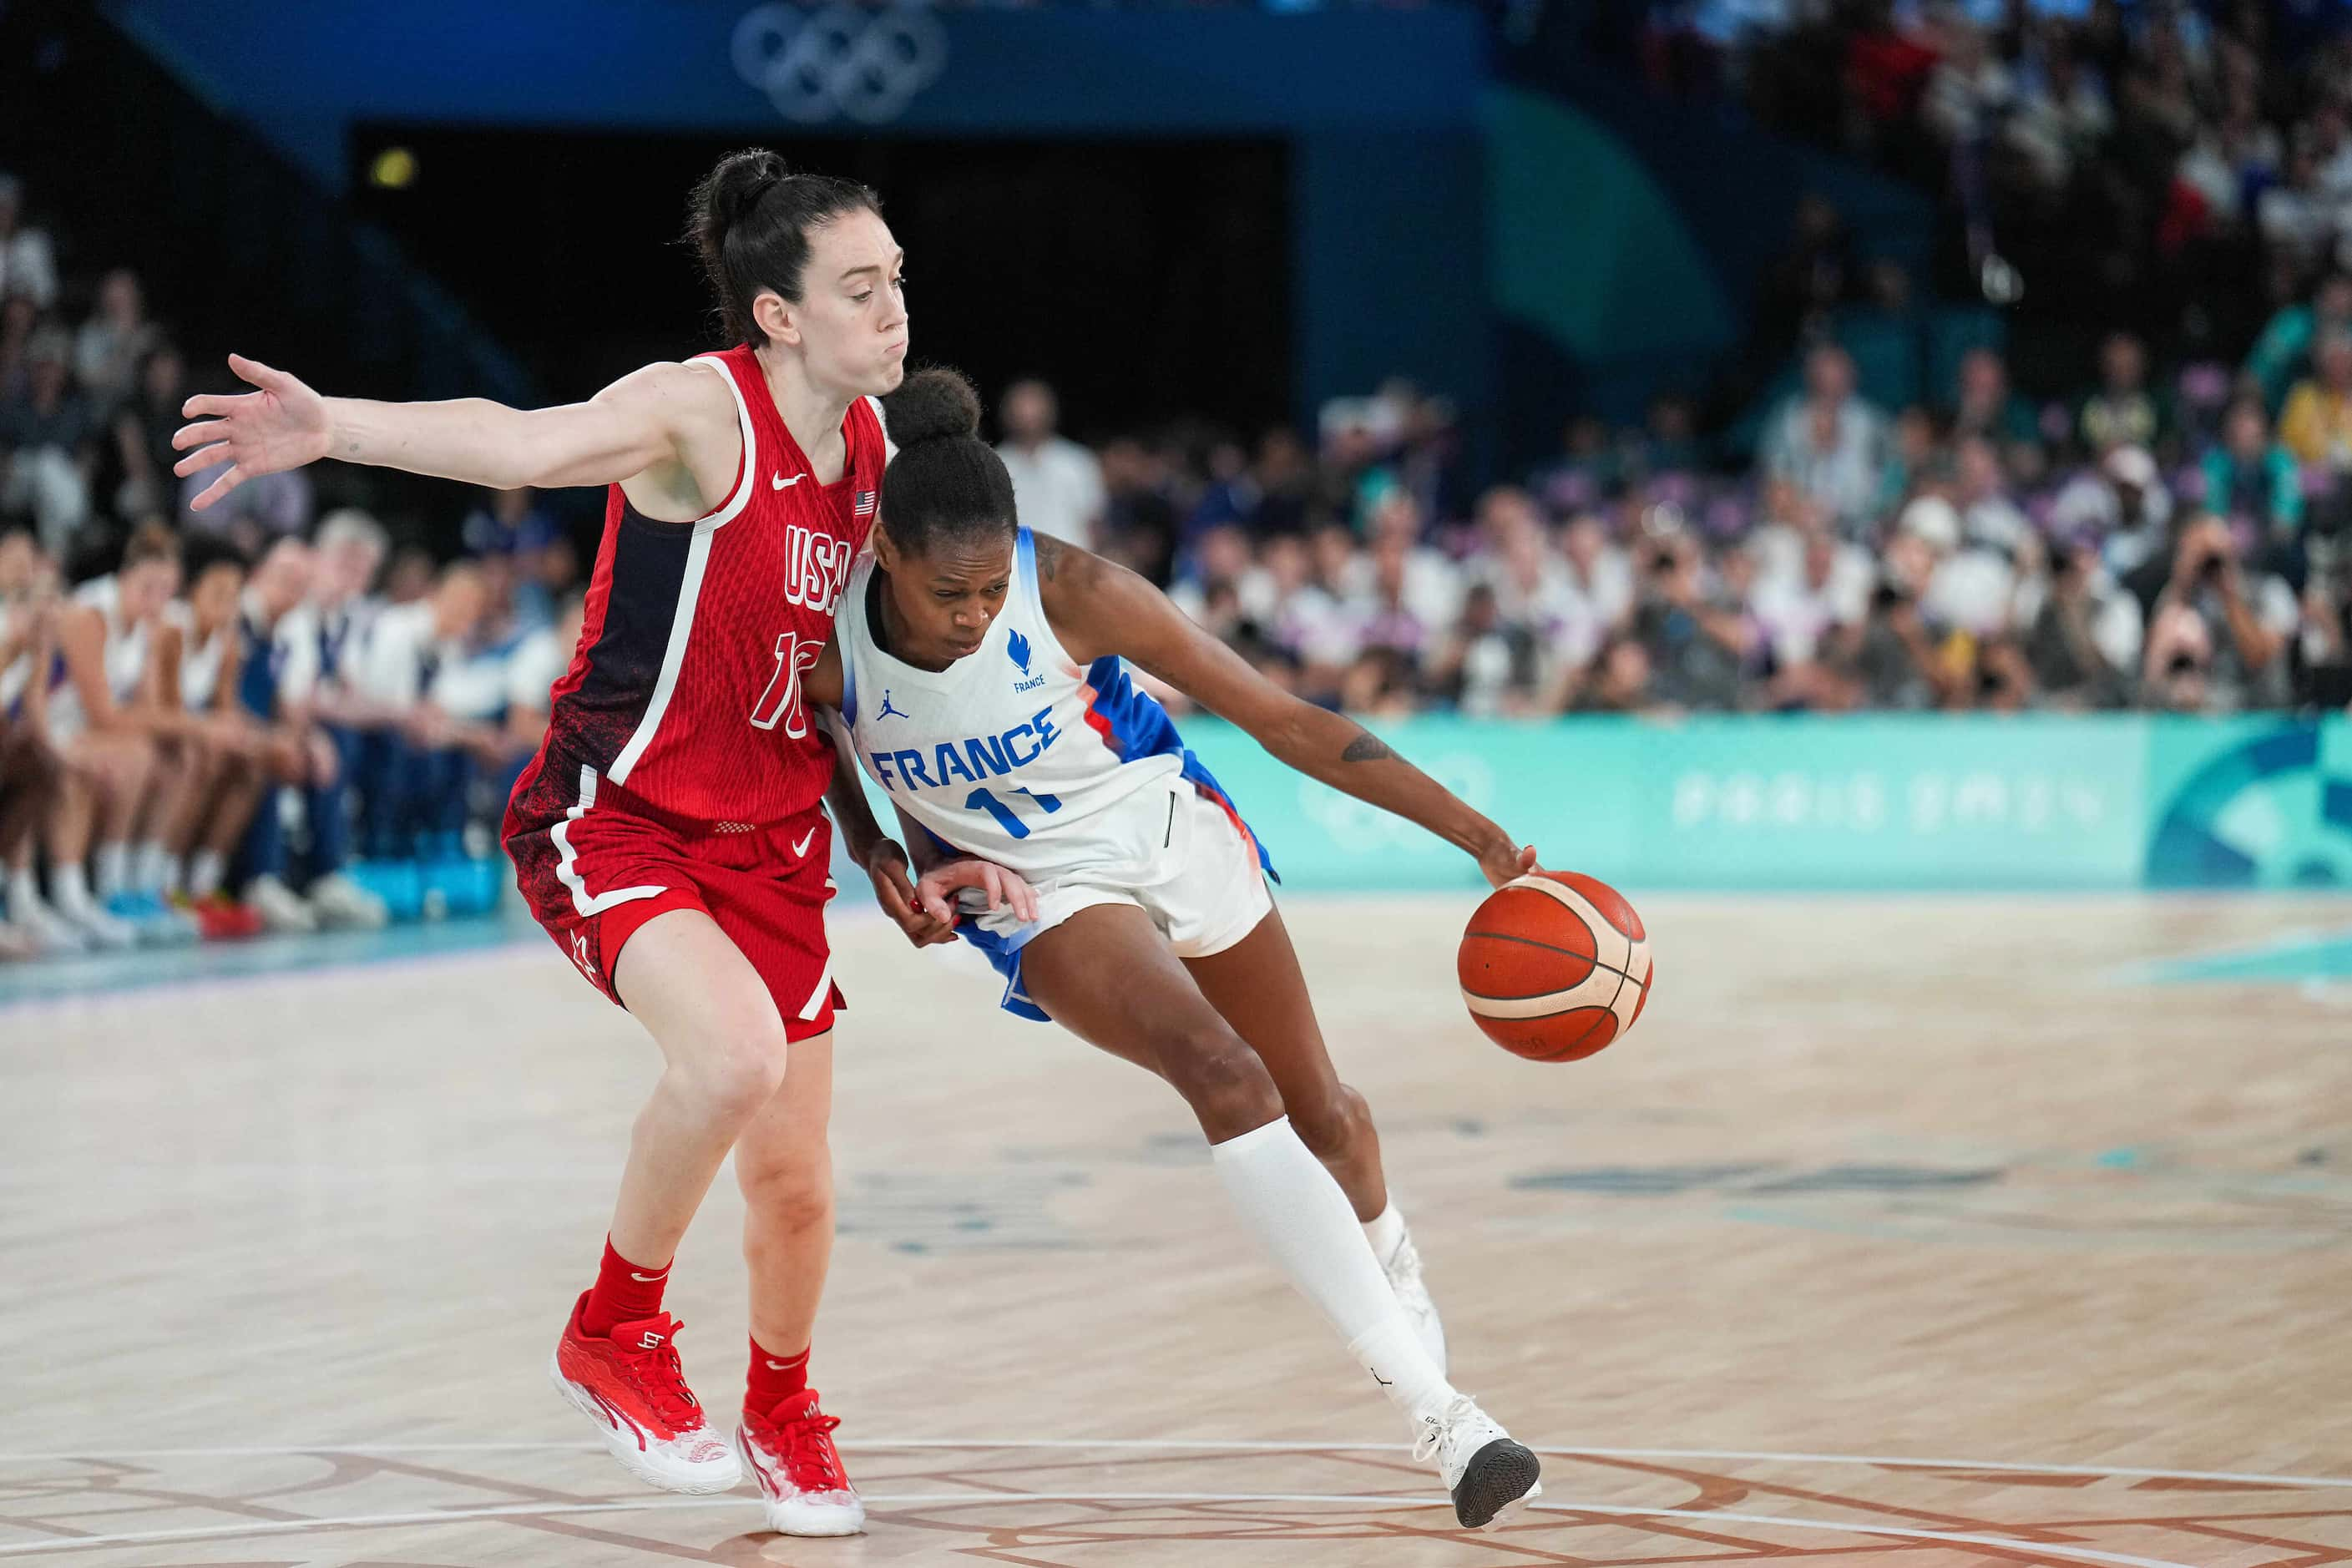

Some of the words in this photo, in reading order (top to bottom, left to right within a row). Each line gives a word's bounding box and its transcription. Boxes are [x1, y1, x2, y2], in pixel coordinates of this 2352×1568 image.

[785, 524, 851, 616] USA
[1014, 674, 1045, 694] FRANCE
[870, 706, 1062, 792] FRANCE
